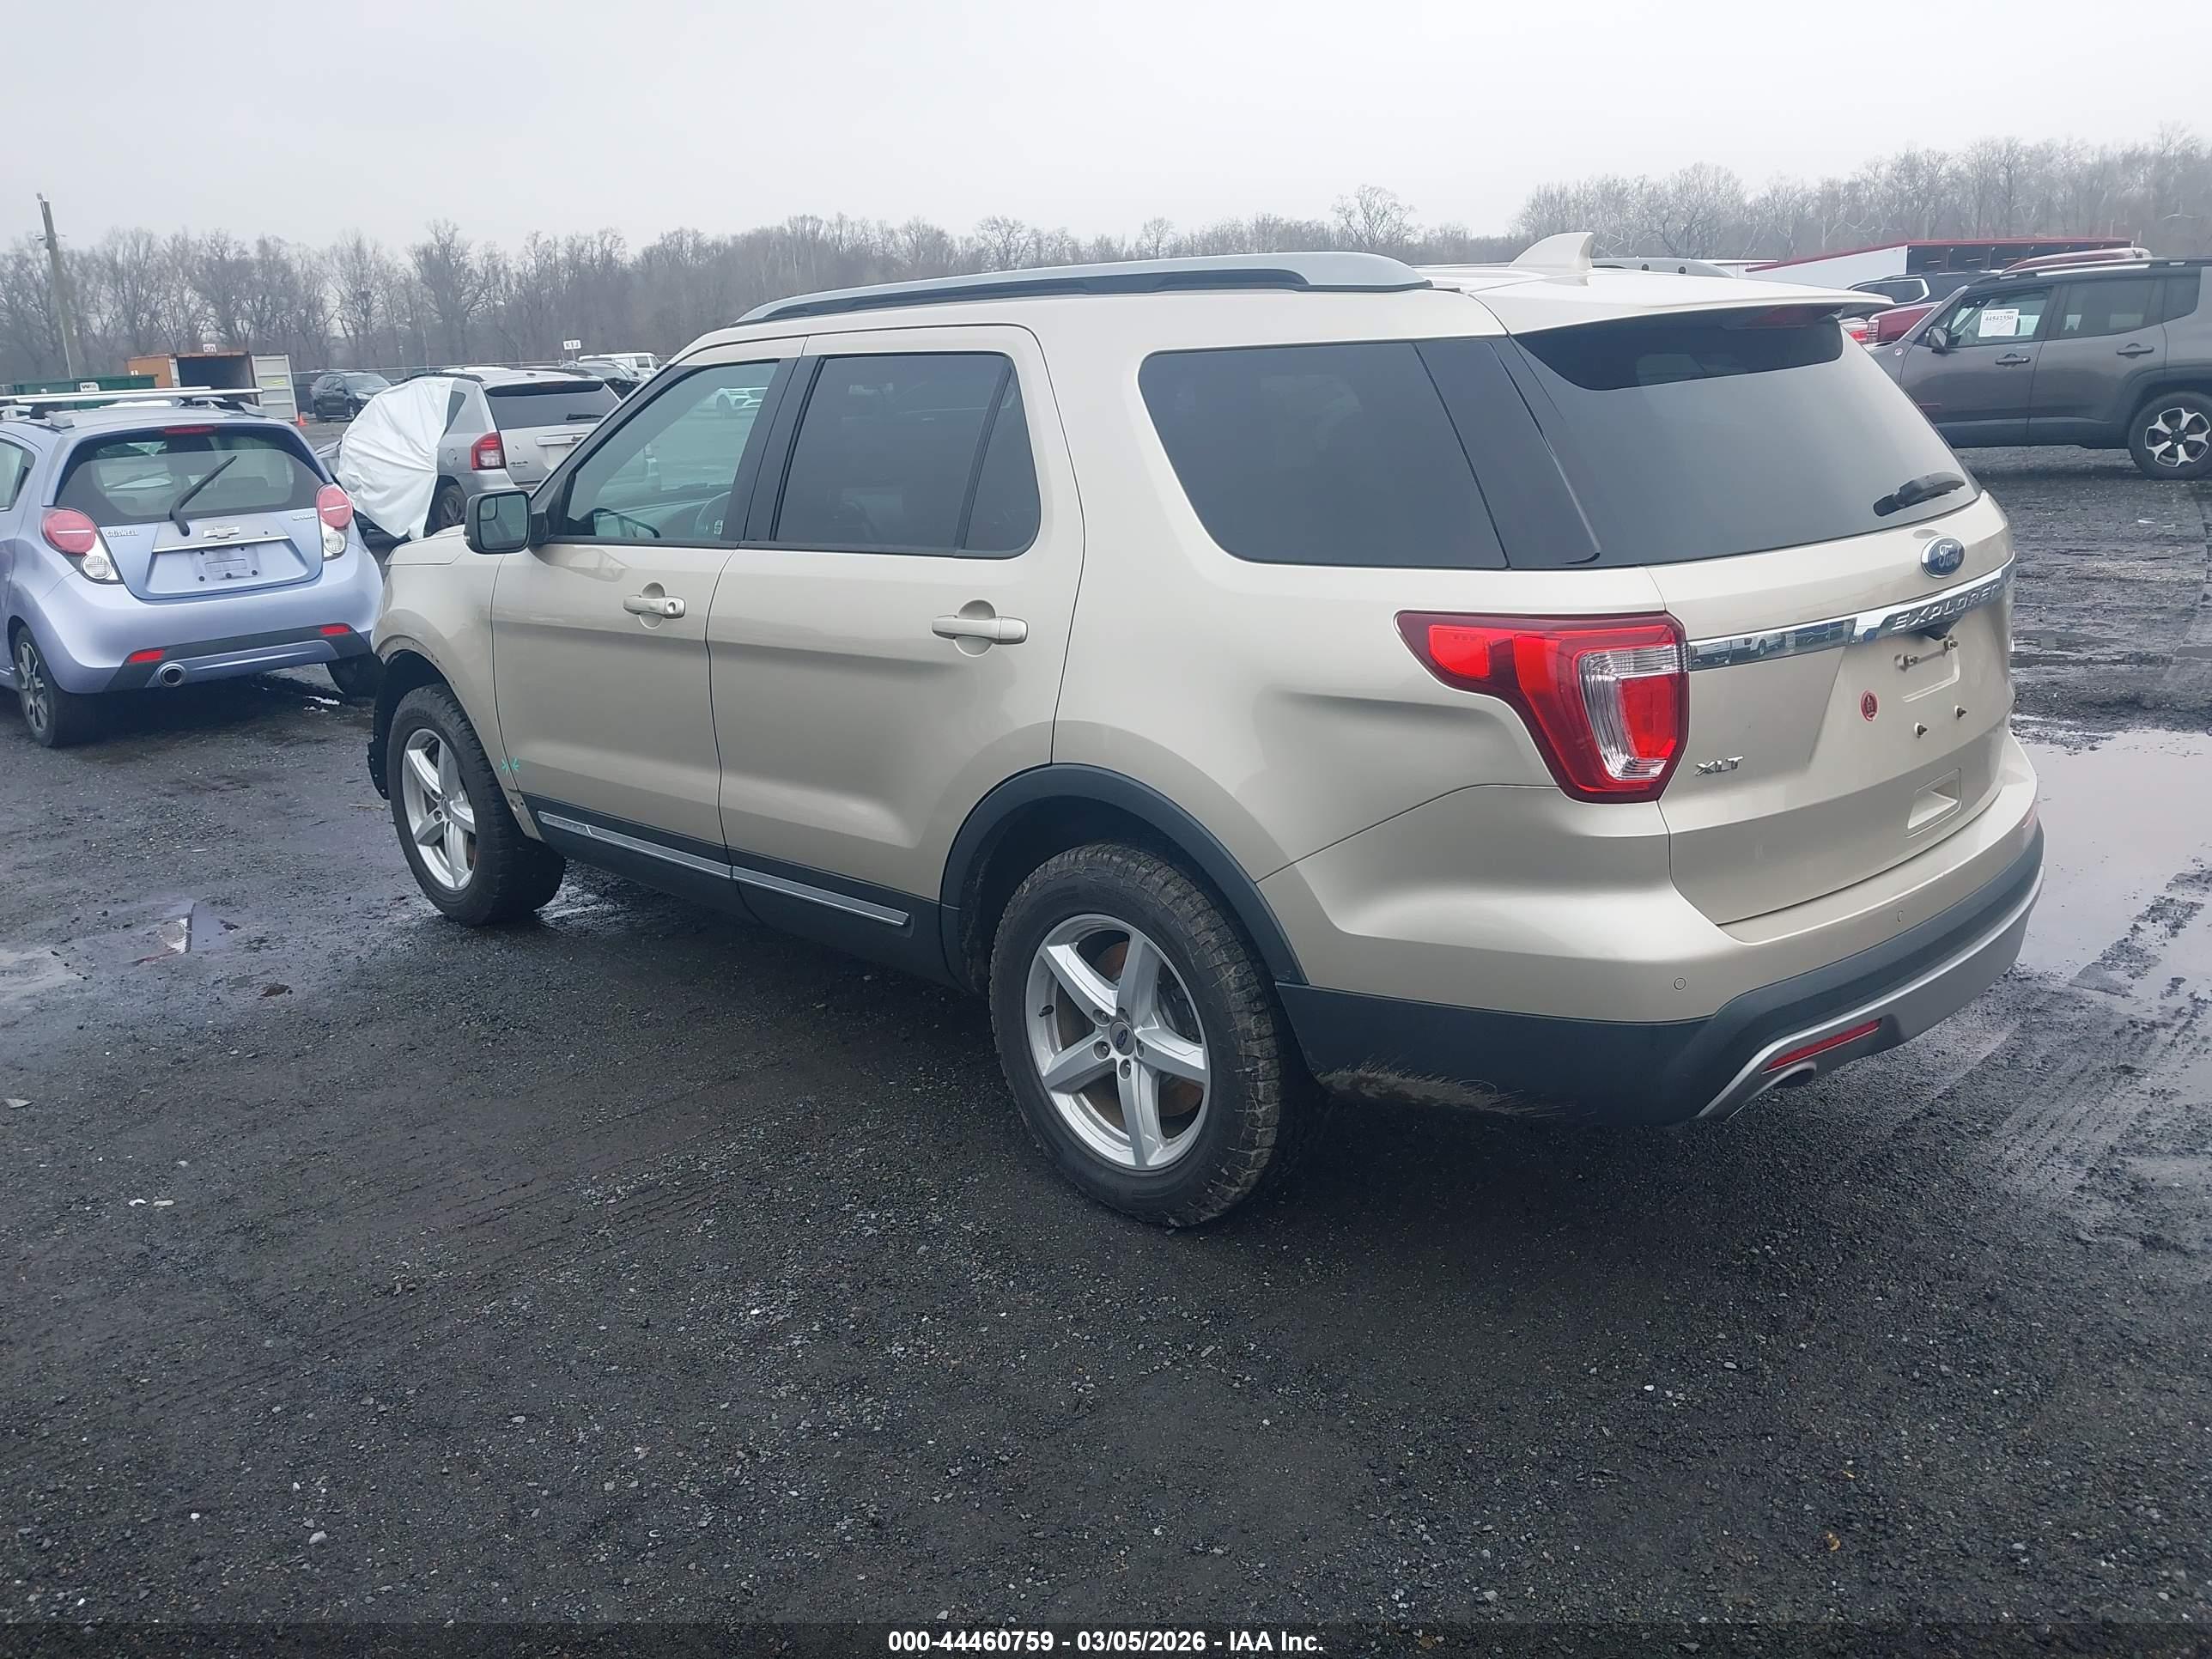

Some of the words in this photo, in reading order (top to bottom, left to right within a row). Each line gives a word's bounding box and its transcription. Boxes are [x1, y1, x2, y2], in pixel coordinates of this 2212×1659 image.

[1938, 544, 1960, 568] Ford
[1891, 584, 2001, 631] EXPLORER
[1695, 755, 1745, 777] XLT
